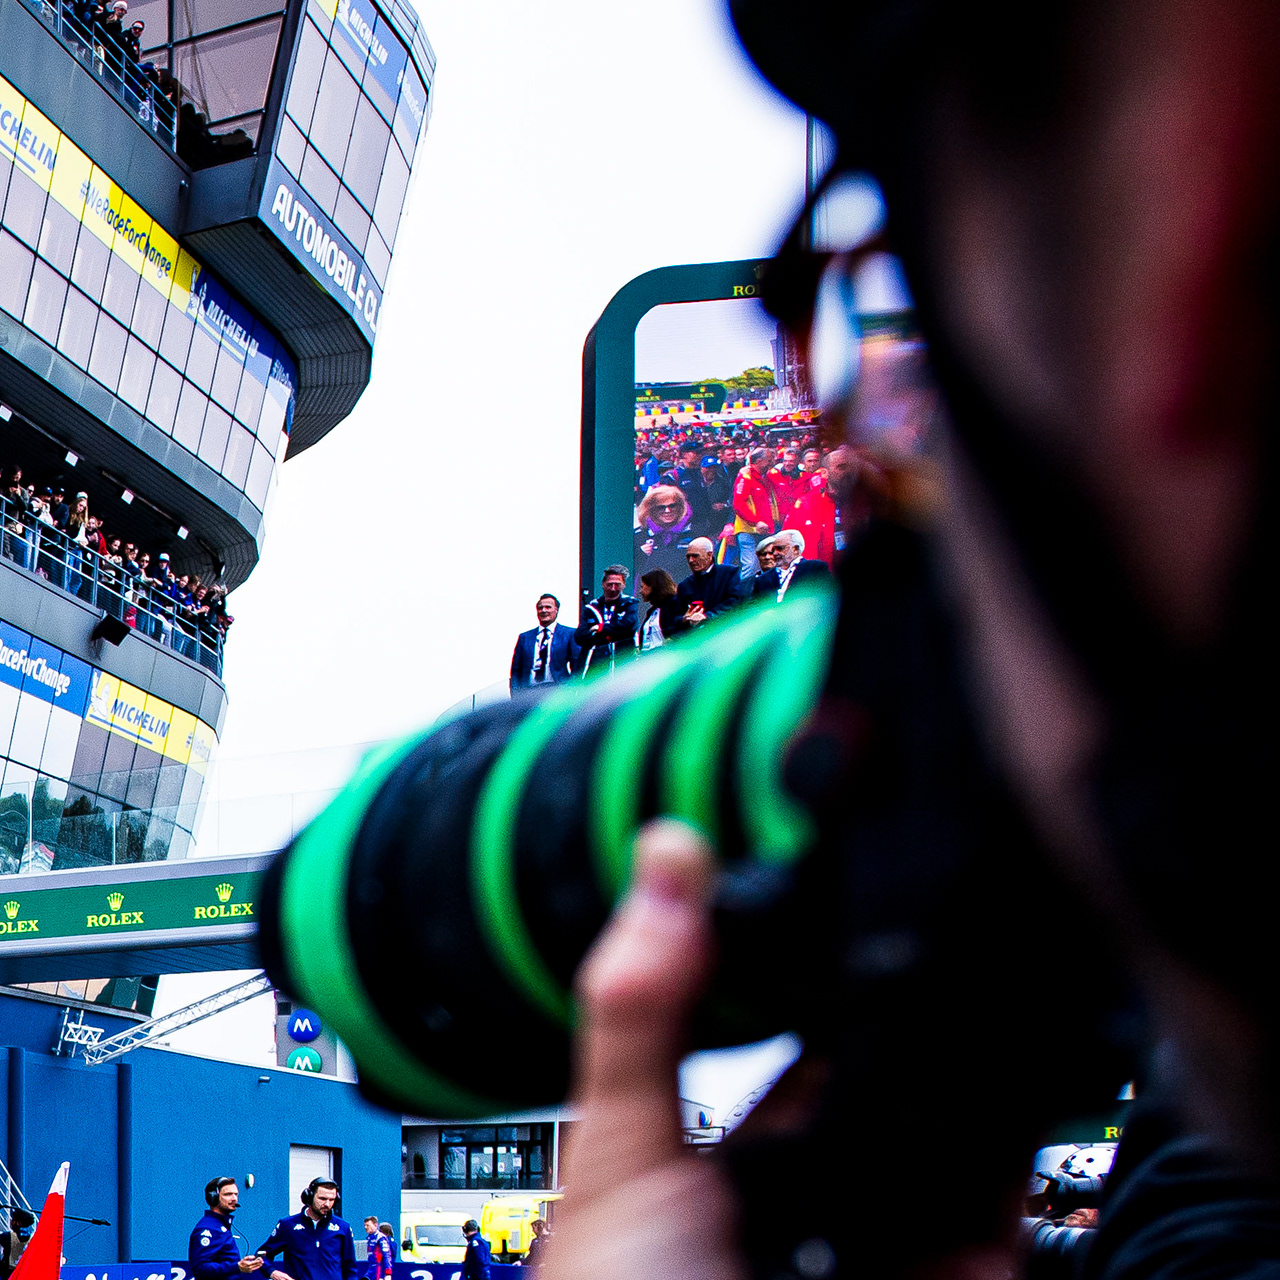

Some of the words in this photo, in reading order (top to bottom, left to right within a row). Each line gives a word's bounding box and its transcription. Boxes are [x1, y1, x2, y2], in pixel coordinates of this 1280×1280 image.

[80, 178, 172, 279] #WeRaceForChange
[271, 184, 368, 314] AUTOMOBILE
[364, 281, 378, 334] CL
[206, 300, 260, 358] MICHELIN
[110, 698, 170, 739] MICHELIN
[86, 911, 144, 929] ROLEX
[194, 902, 253, 920] ROLEX
